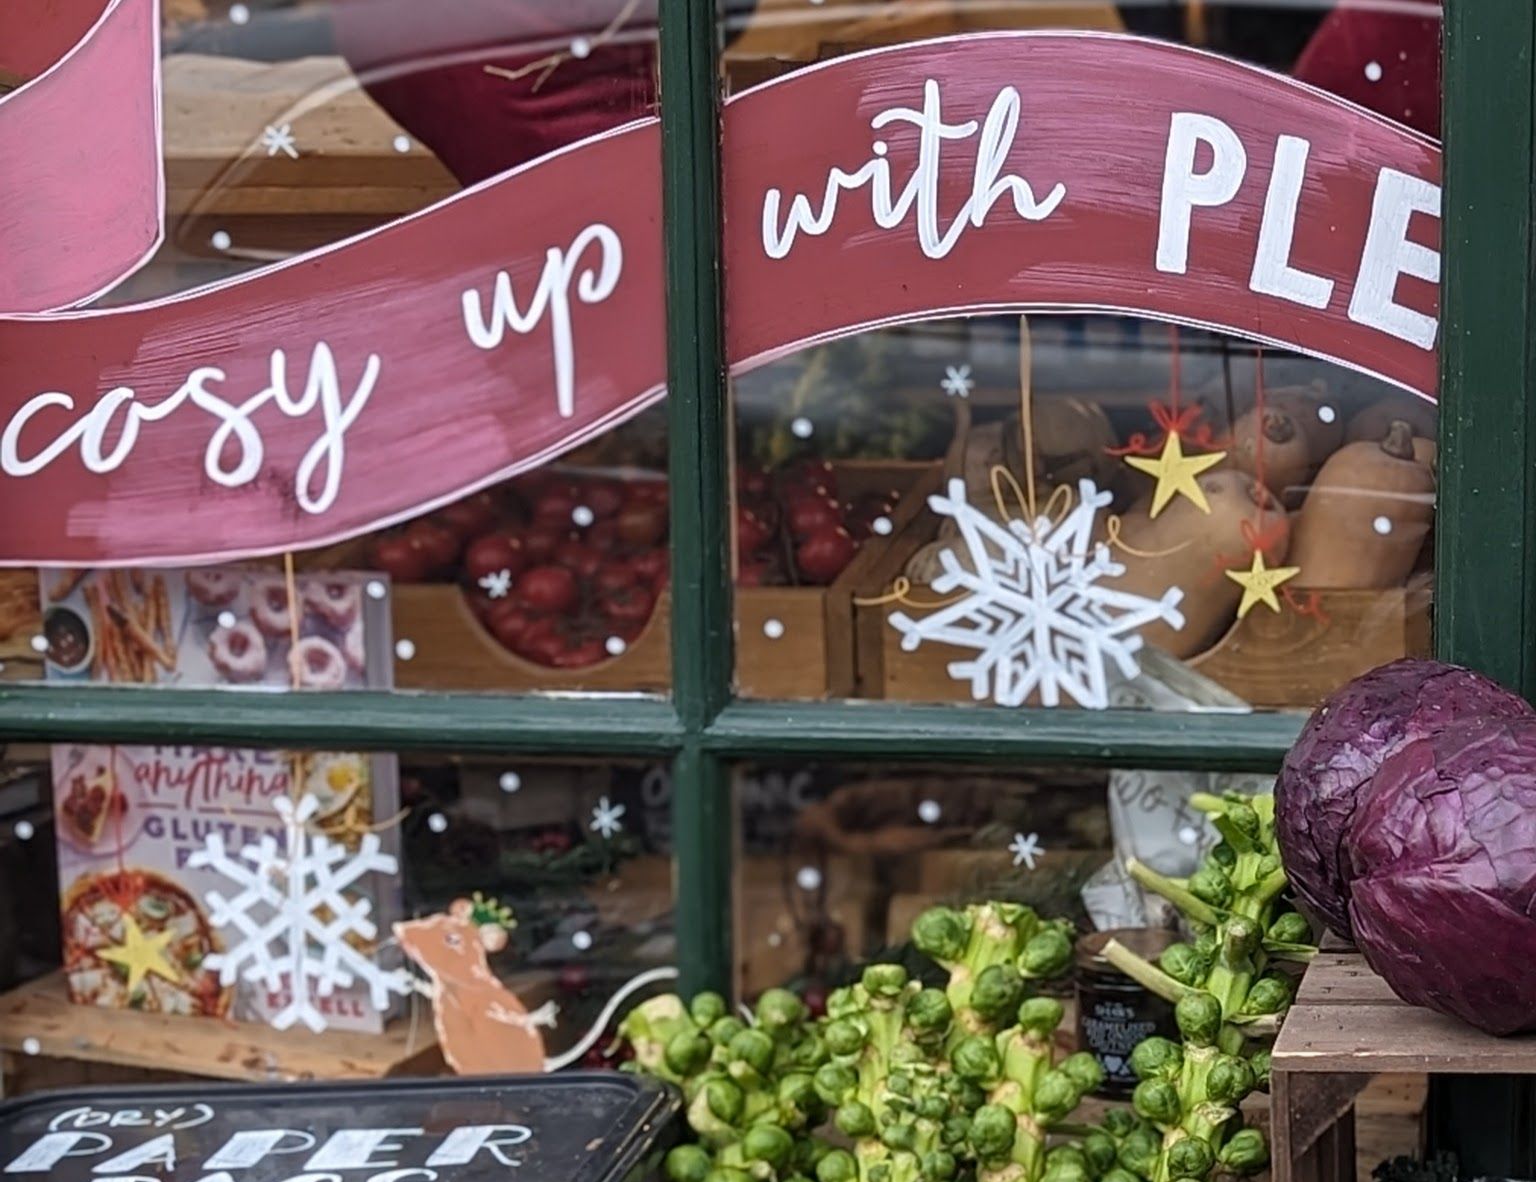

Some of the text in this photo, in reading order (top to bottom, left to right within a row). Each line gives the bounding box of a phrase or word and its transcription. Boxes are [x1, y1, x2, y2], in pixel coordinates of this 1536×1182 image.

[0, 342, 380, 513] cosy
[462, 223, 622, 416] up
[762, 79, 1066, 259] with
[49, 1104, 213, 1130] (DRY)
[3, 1125, 533, 1172] PAPER
